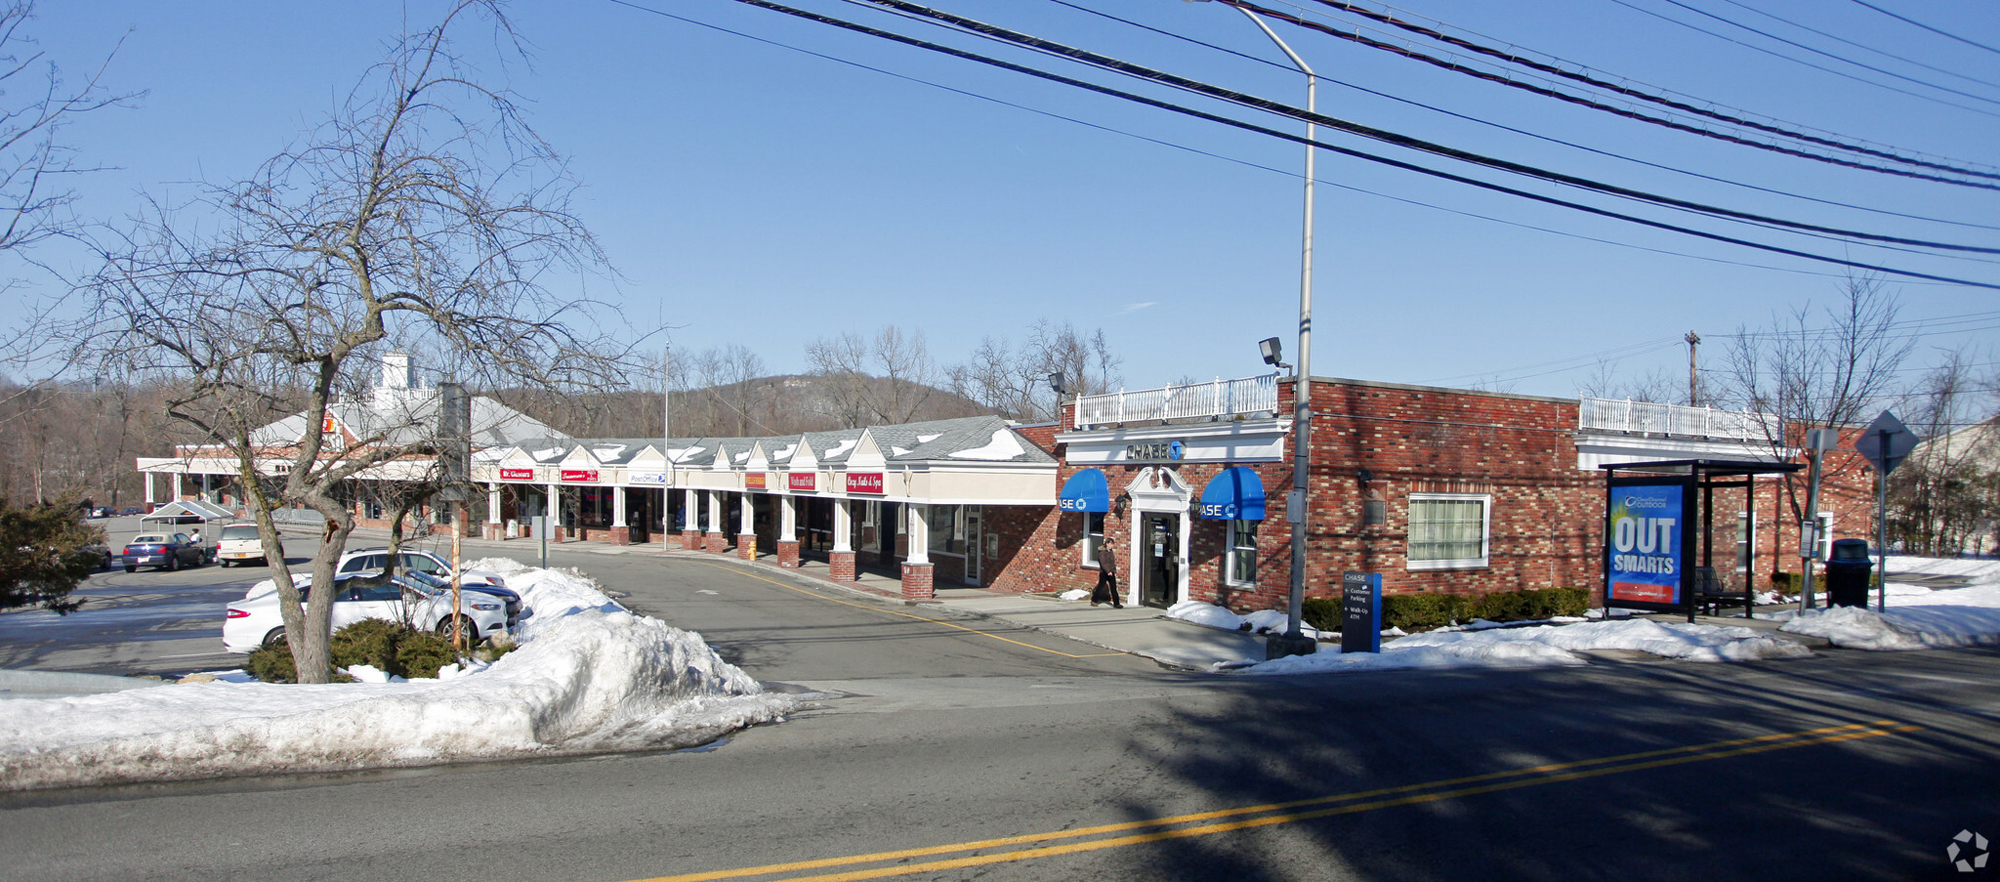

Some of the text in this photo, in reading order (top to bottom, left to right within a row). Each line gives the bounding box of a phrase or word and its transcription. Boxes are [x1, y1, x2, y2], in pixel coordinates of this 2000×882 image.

[1126, 444, 1168, 459] CHASE
[873, 476, 881, 489] Spa
[1615, 516, 1675, 554] OUT
[1614, 555, 1673, 574] SMARTS
[1345, 573, 1365, 582] CHASE
[1350, 595, 1366, 603] Parking
